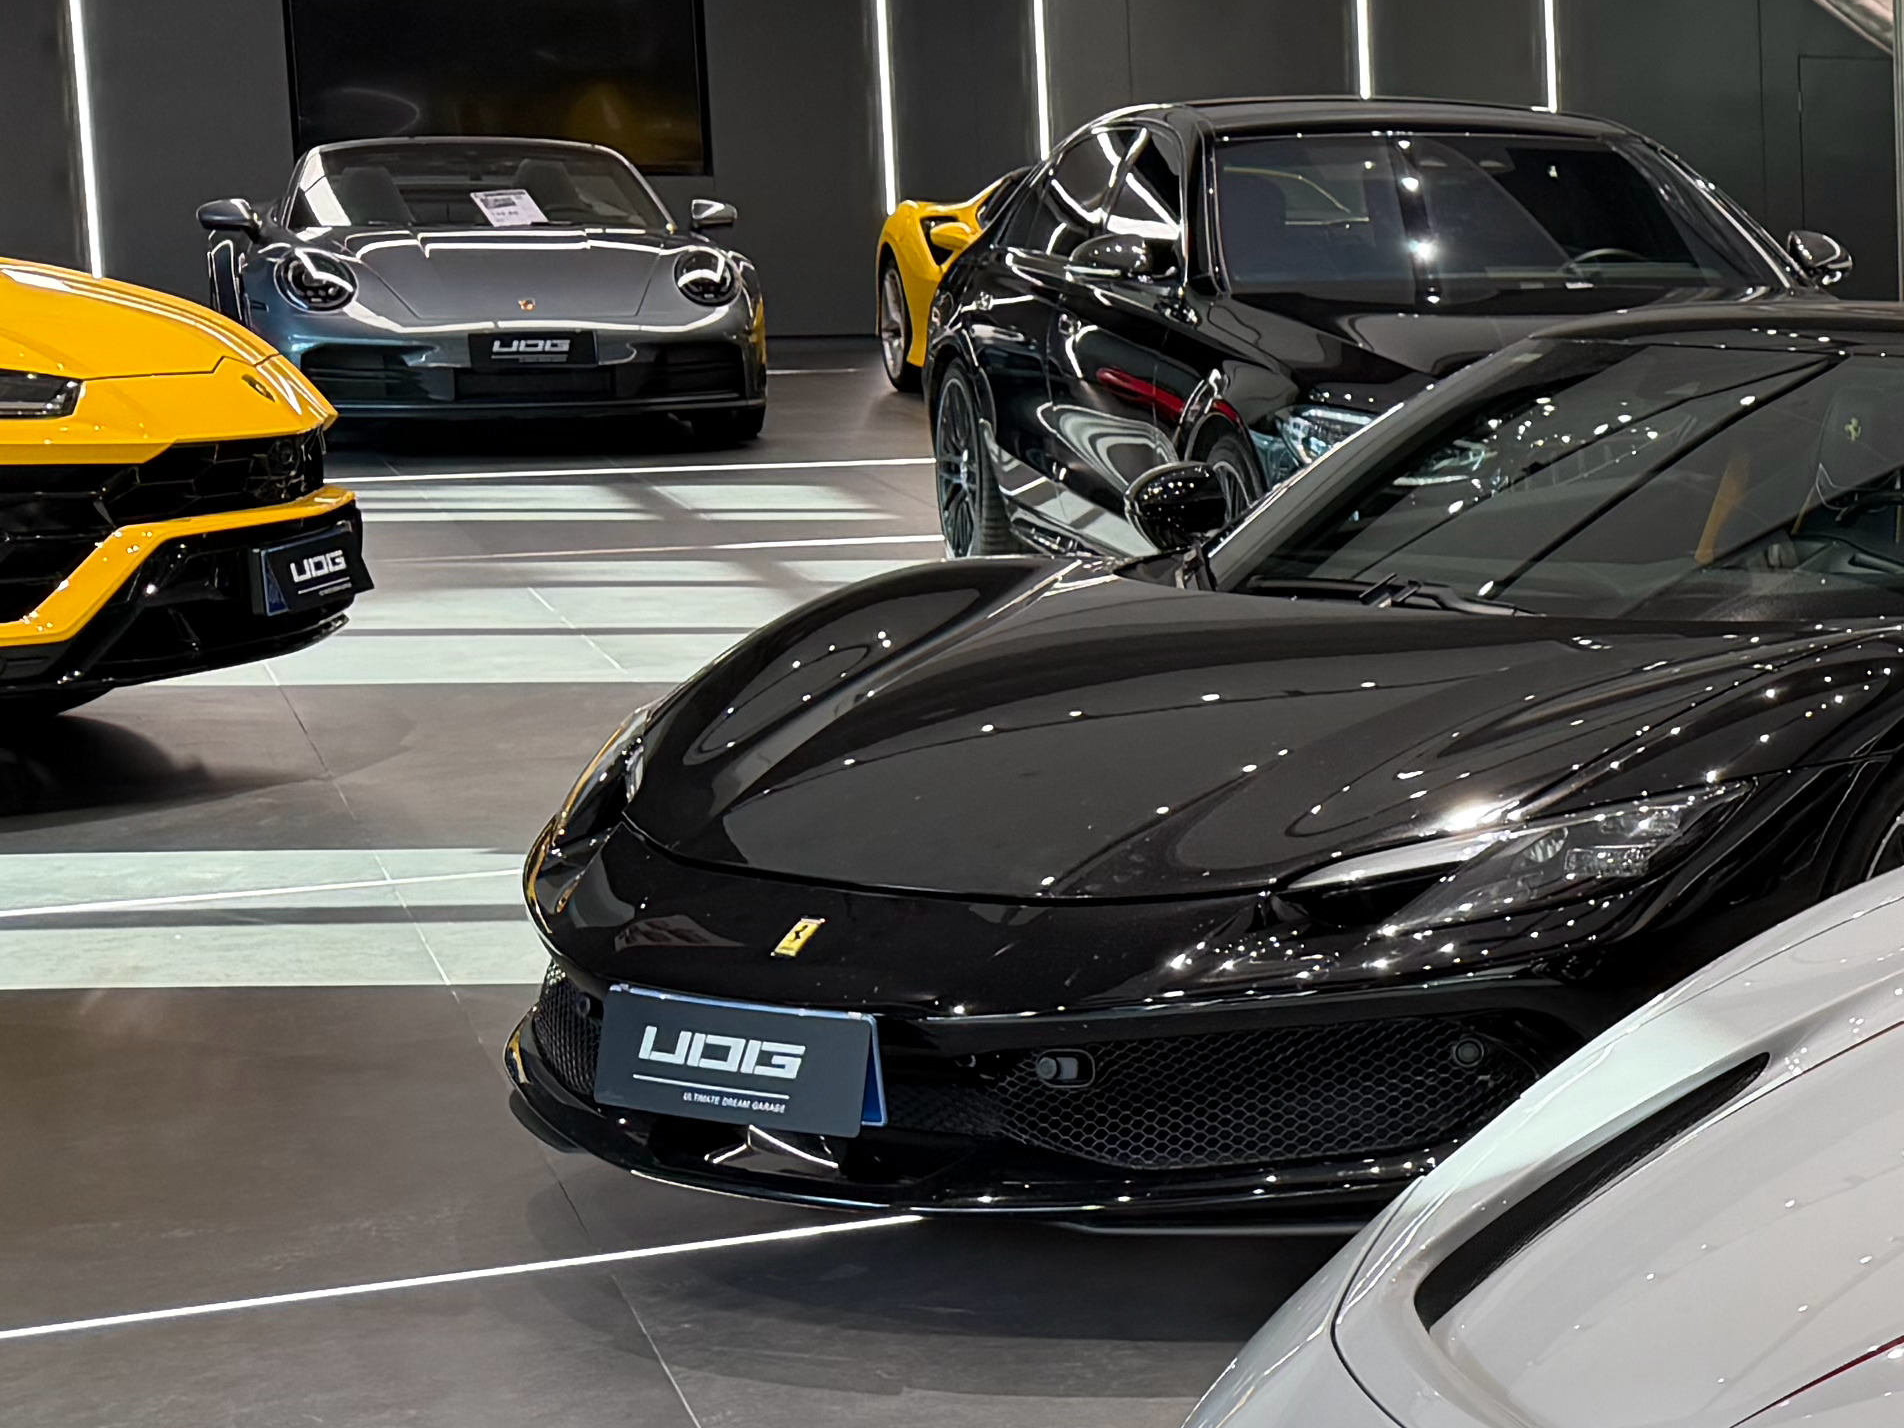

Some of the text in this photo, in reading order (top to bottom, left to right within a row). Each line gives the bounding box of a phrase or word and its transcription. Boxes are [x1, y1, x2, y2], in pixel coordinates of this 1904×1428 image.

[491, 339, 571, 353] UDG
[289, 549, 347, 583] UDG
[638, 1025, 806, 1079] UDG
